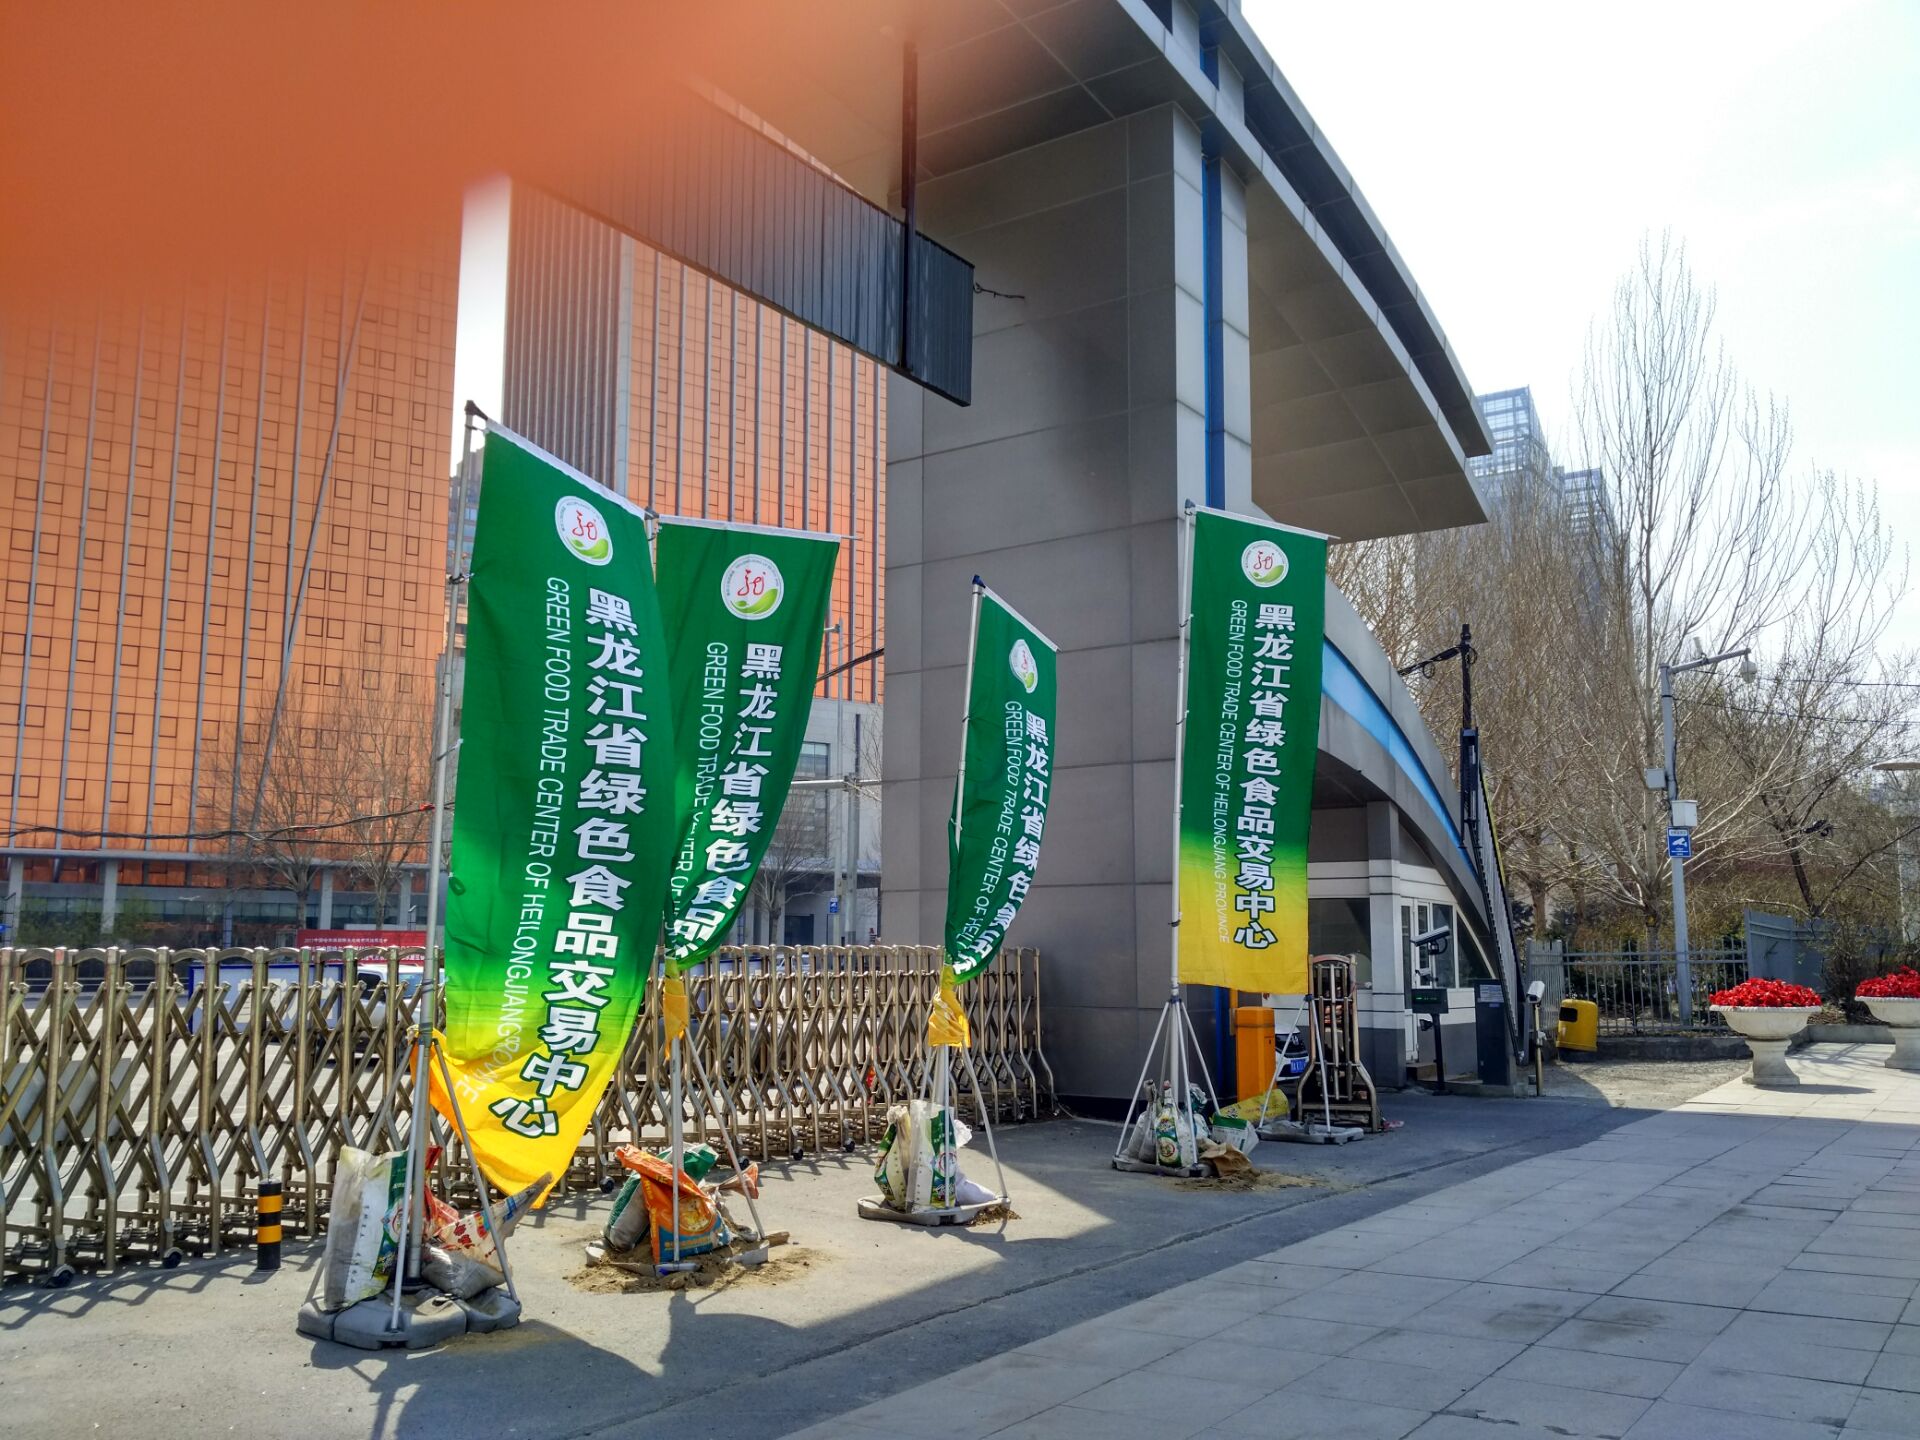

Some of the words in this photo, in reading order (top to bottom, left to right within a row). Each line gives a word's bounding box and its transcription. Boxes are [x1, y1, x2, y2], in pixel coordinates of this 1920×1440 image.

[546, 577, 570, 643] GREEN
[1231, 599, 1247, 641] GREEN
[545, 646, 571, 702] FOOD
[703, 641, 729, 700] GREEN
[1228, 644, 1244, 678] FOOD
[699, 704, 724, 750] FOOD
[1005, 700, 1023, 746] GREEN
[1223, 681, 1240, 721] TRADE
[539, 708, 569, 773] TRADE
[1006, 747, 1022, 786] FOOD
[1217, 723, 1236, 772] CENTER
[694, 753, 718, 807] TRADE
[1215, 773, 1231, 790] OF
[1234, 603, 1295, 948] 黑龙江省绿色食品交易中心
[528, 778, 564, 857] CENTER
[997, 789, 1017, 836] TRADE
[1213, 792, 1230, 880] HEILONGJIANG
[491, 586, 648, 1137] 黑龙江省绿色食品交易中心
[525, 862, 552, 889] OF
[980, 837, 1008, 894] CENTER
[973, 895, 990, 916] OF
[1215, 882, 1230, 943] PROVINCE
[497, 894, 546, 1037] HEILONGJIANG
